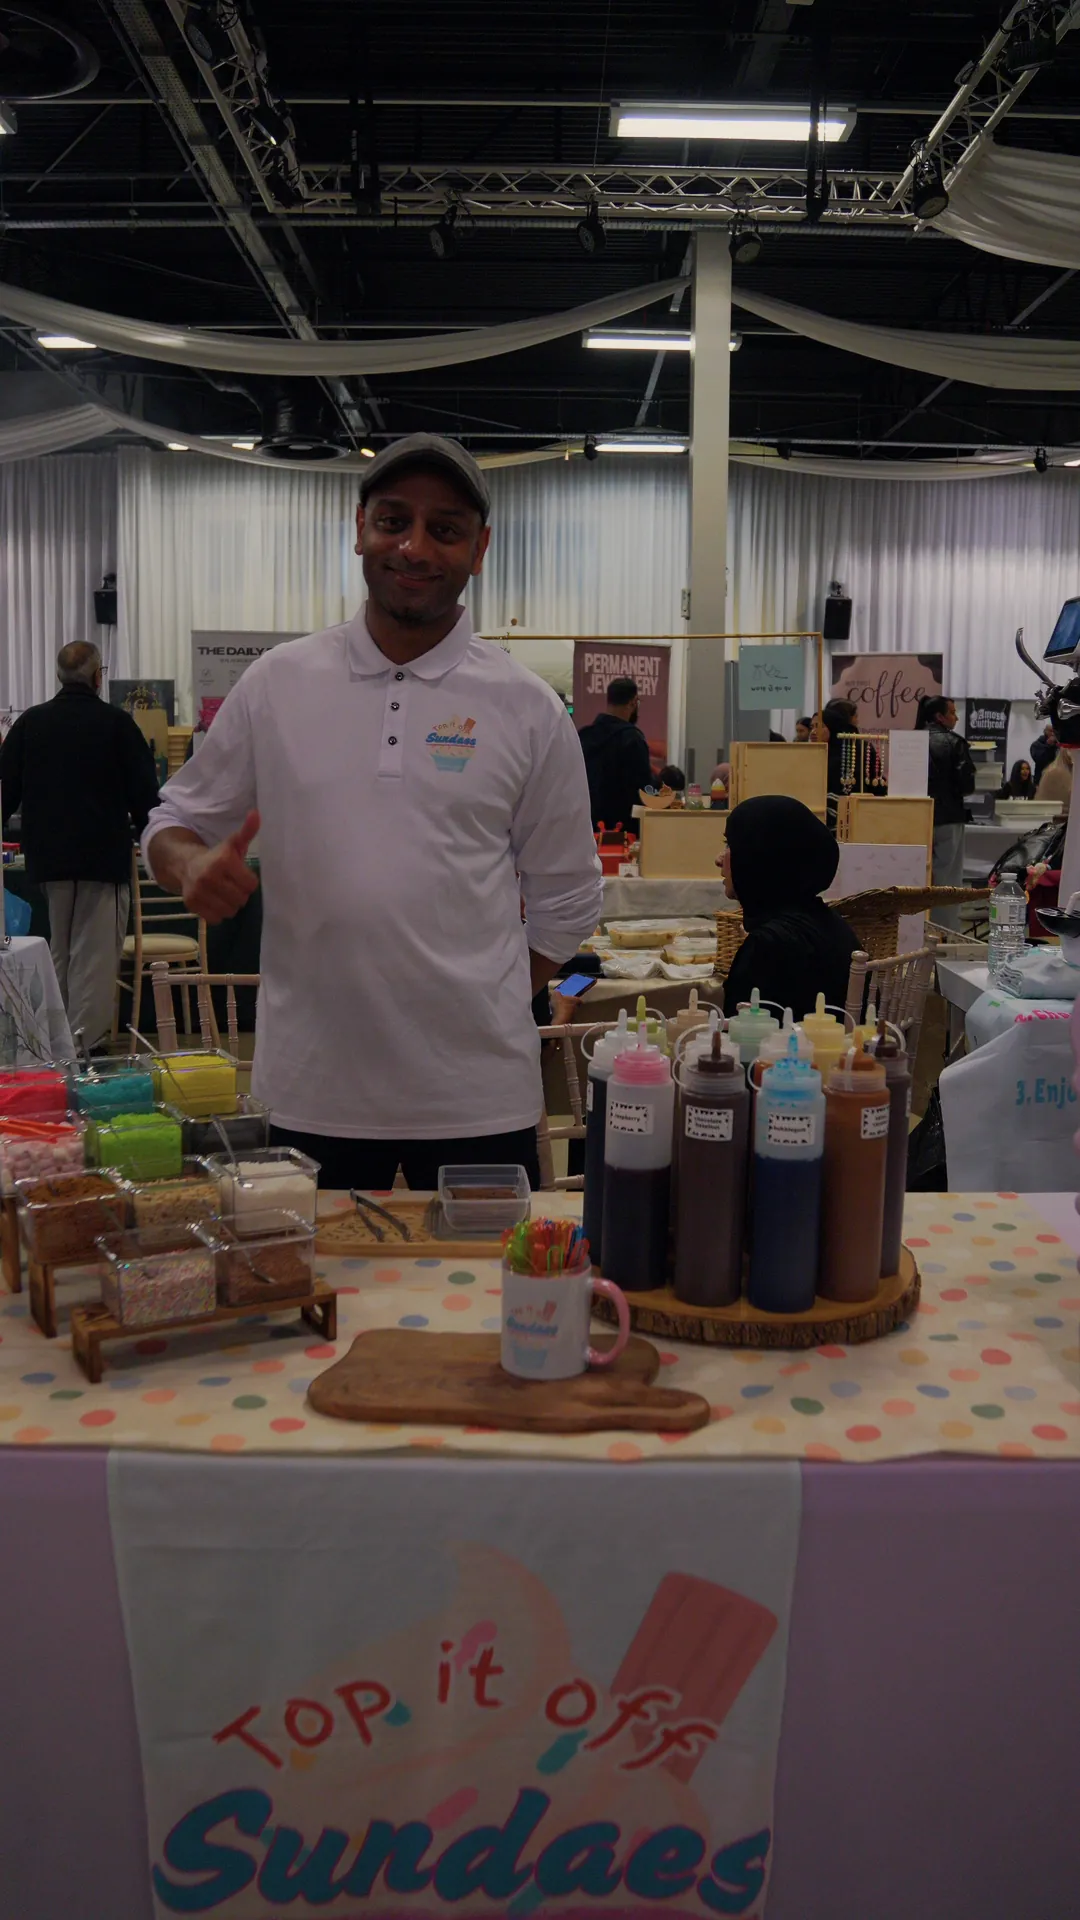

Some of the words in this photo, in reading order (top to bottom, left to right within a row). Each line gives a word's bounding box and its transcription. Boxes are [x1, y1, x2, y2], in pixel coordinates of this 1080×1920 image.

[197, 646, 225, 655] THE
[226, 646, 265, 656] DAILY
[584, 653, 661, 676] PERMANENT
[847, 670, 926, 718] coffee
[425, 732, 477, 746] Sundaes
[437, 1640, 503, 1708] it
[152, 1786, 771, 1915] Sundaes
